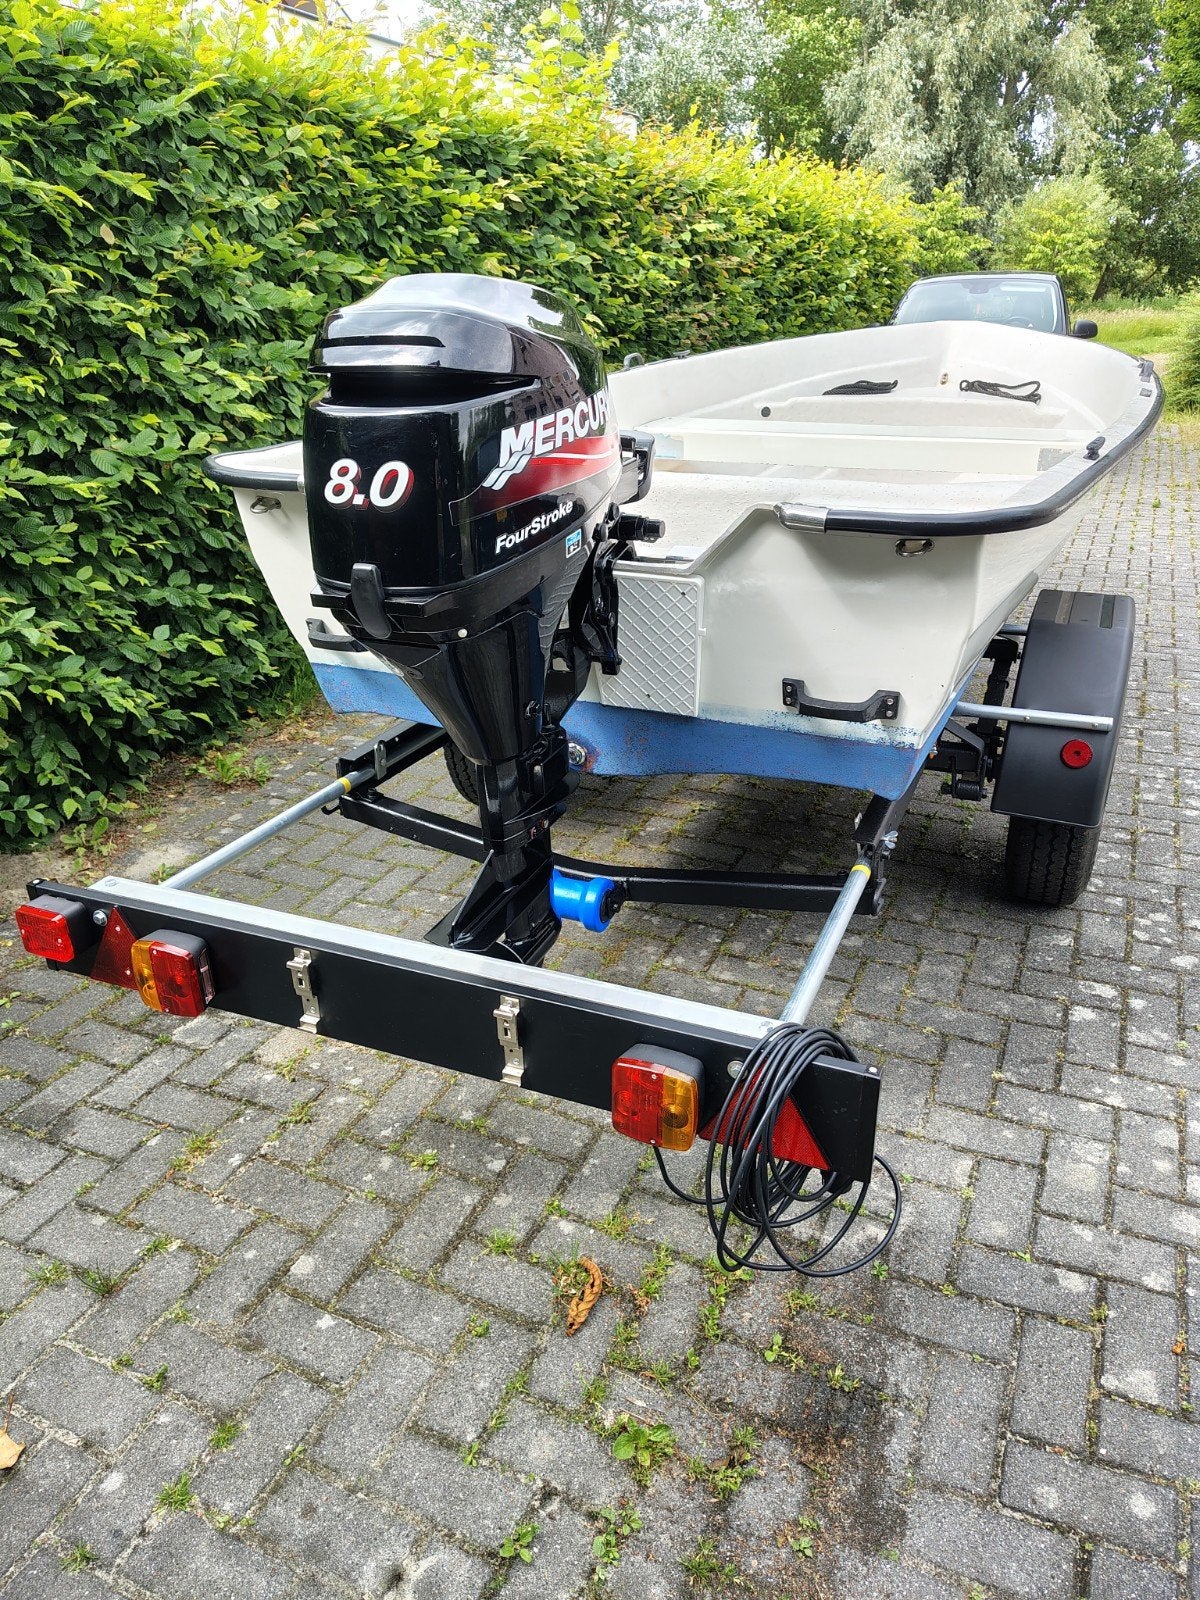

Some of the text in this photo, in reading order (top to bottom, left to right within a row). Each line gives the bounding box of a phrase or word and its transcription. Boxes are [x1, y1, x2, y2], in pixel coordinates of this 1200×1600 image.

[499, 386, 609, 468] MERCUR
[324, 458, 414, 512] 8.0
[495, 500, 573, 554] FourStroke
